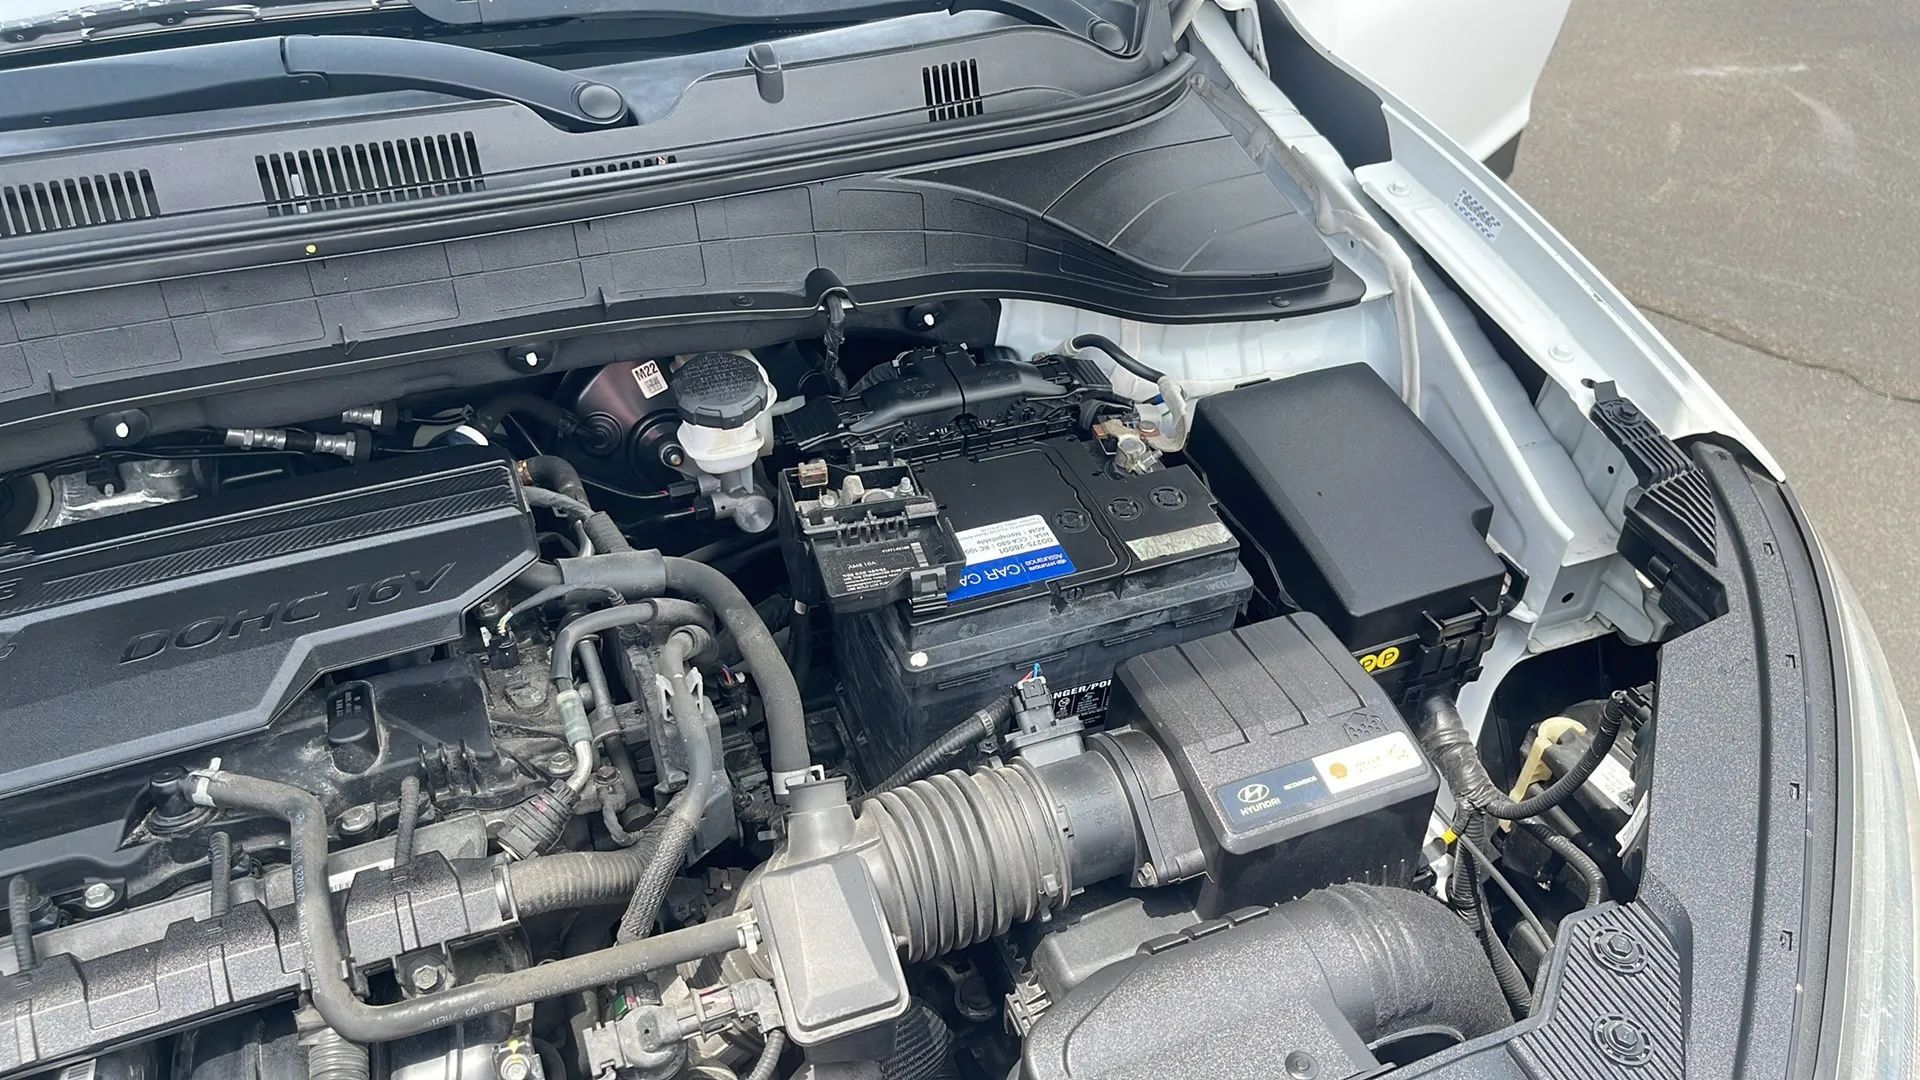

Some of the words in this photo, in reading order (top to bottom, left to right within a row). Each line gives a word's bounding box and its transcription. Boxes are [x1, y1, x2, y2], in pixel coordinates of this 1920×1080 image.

[634, 362, 658, 381] M22
[983, 564, 1021, 580] CAR
[1028, 560, 1056, 571] HYUNDAI
[960, 573, 981, 587] CA
[119, 591, 328, 665] DOHC
[346, 561, 456, 611] 16V
[1053, 679, 1112, 699] NGER/POI
[1240, 797, 1281, 816] HYUNDAI
